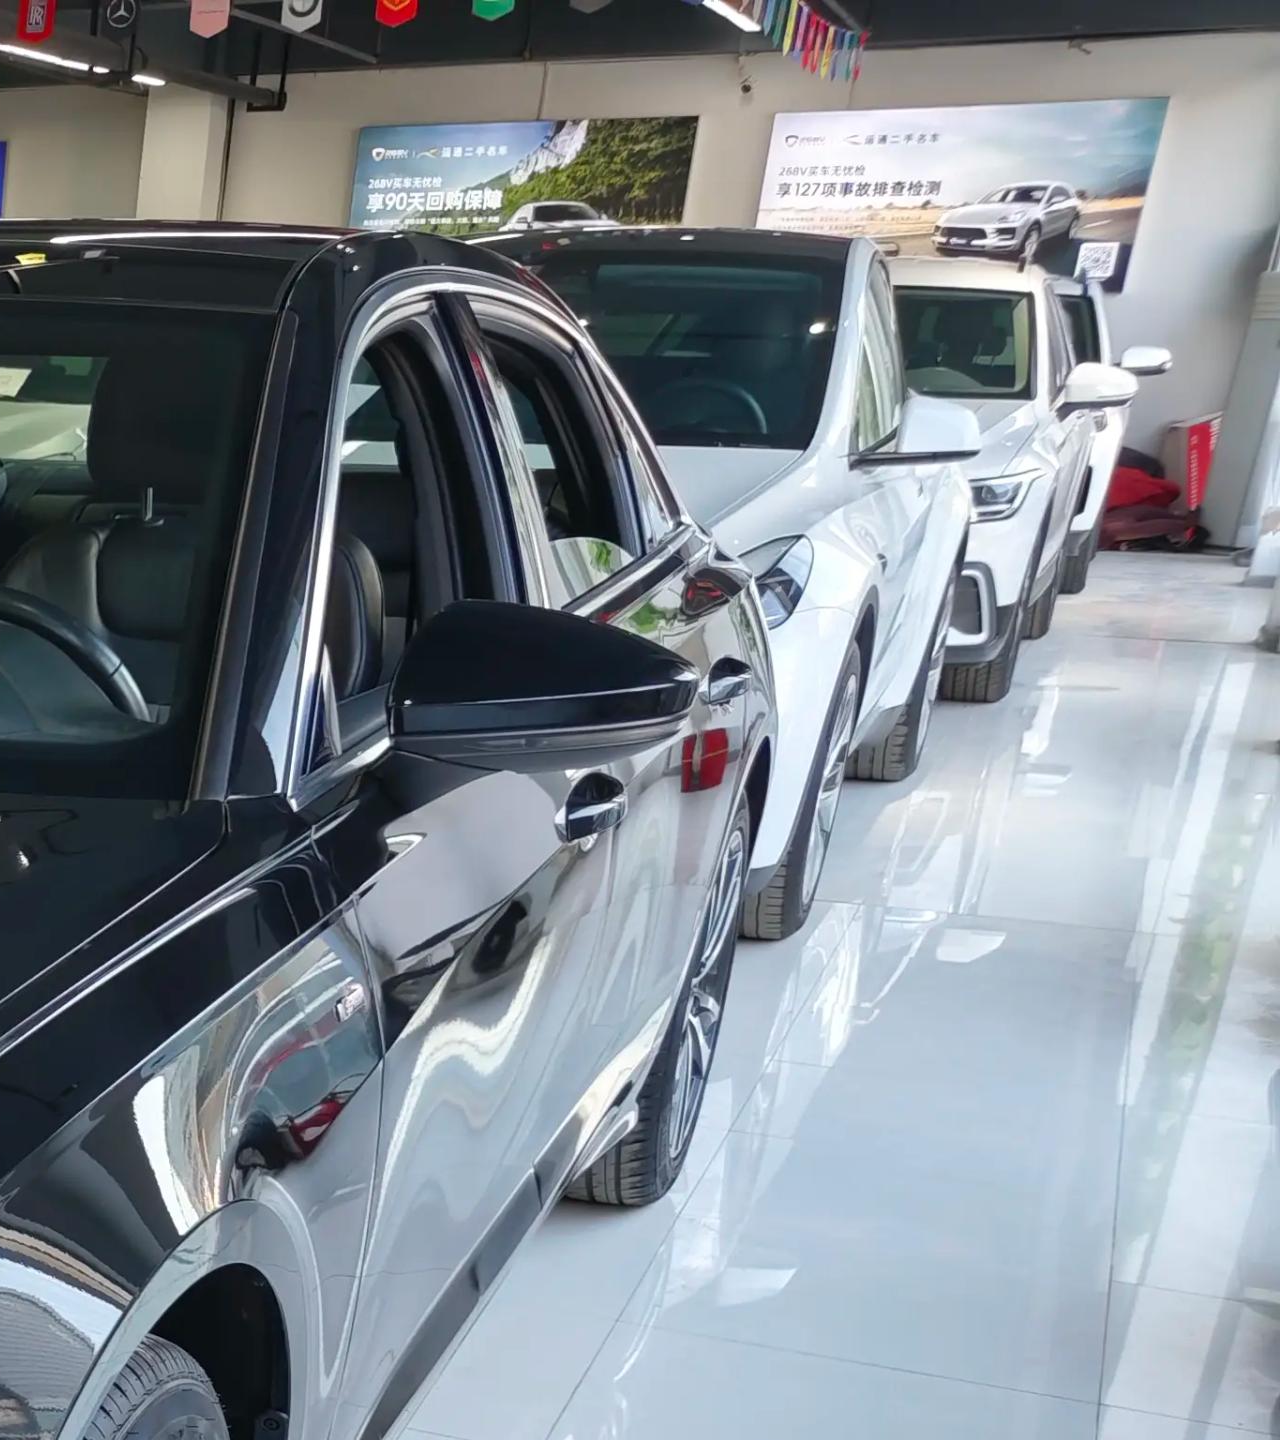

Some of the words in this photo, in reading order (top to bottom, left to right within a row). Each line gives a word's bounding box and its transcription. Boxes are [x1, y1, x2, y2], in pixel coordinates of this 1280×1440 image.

[777, 181, 941, 198] 享127项事故排查检测
[366, 188, 502, 212] 享90天回购保障
